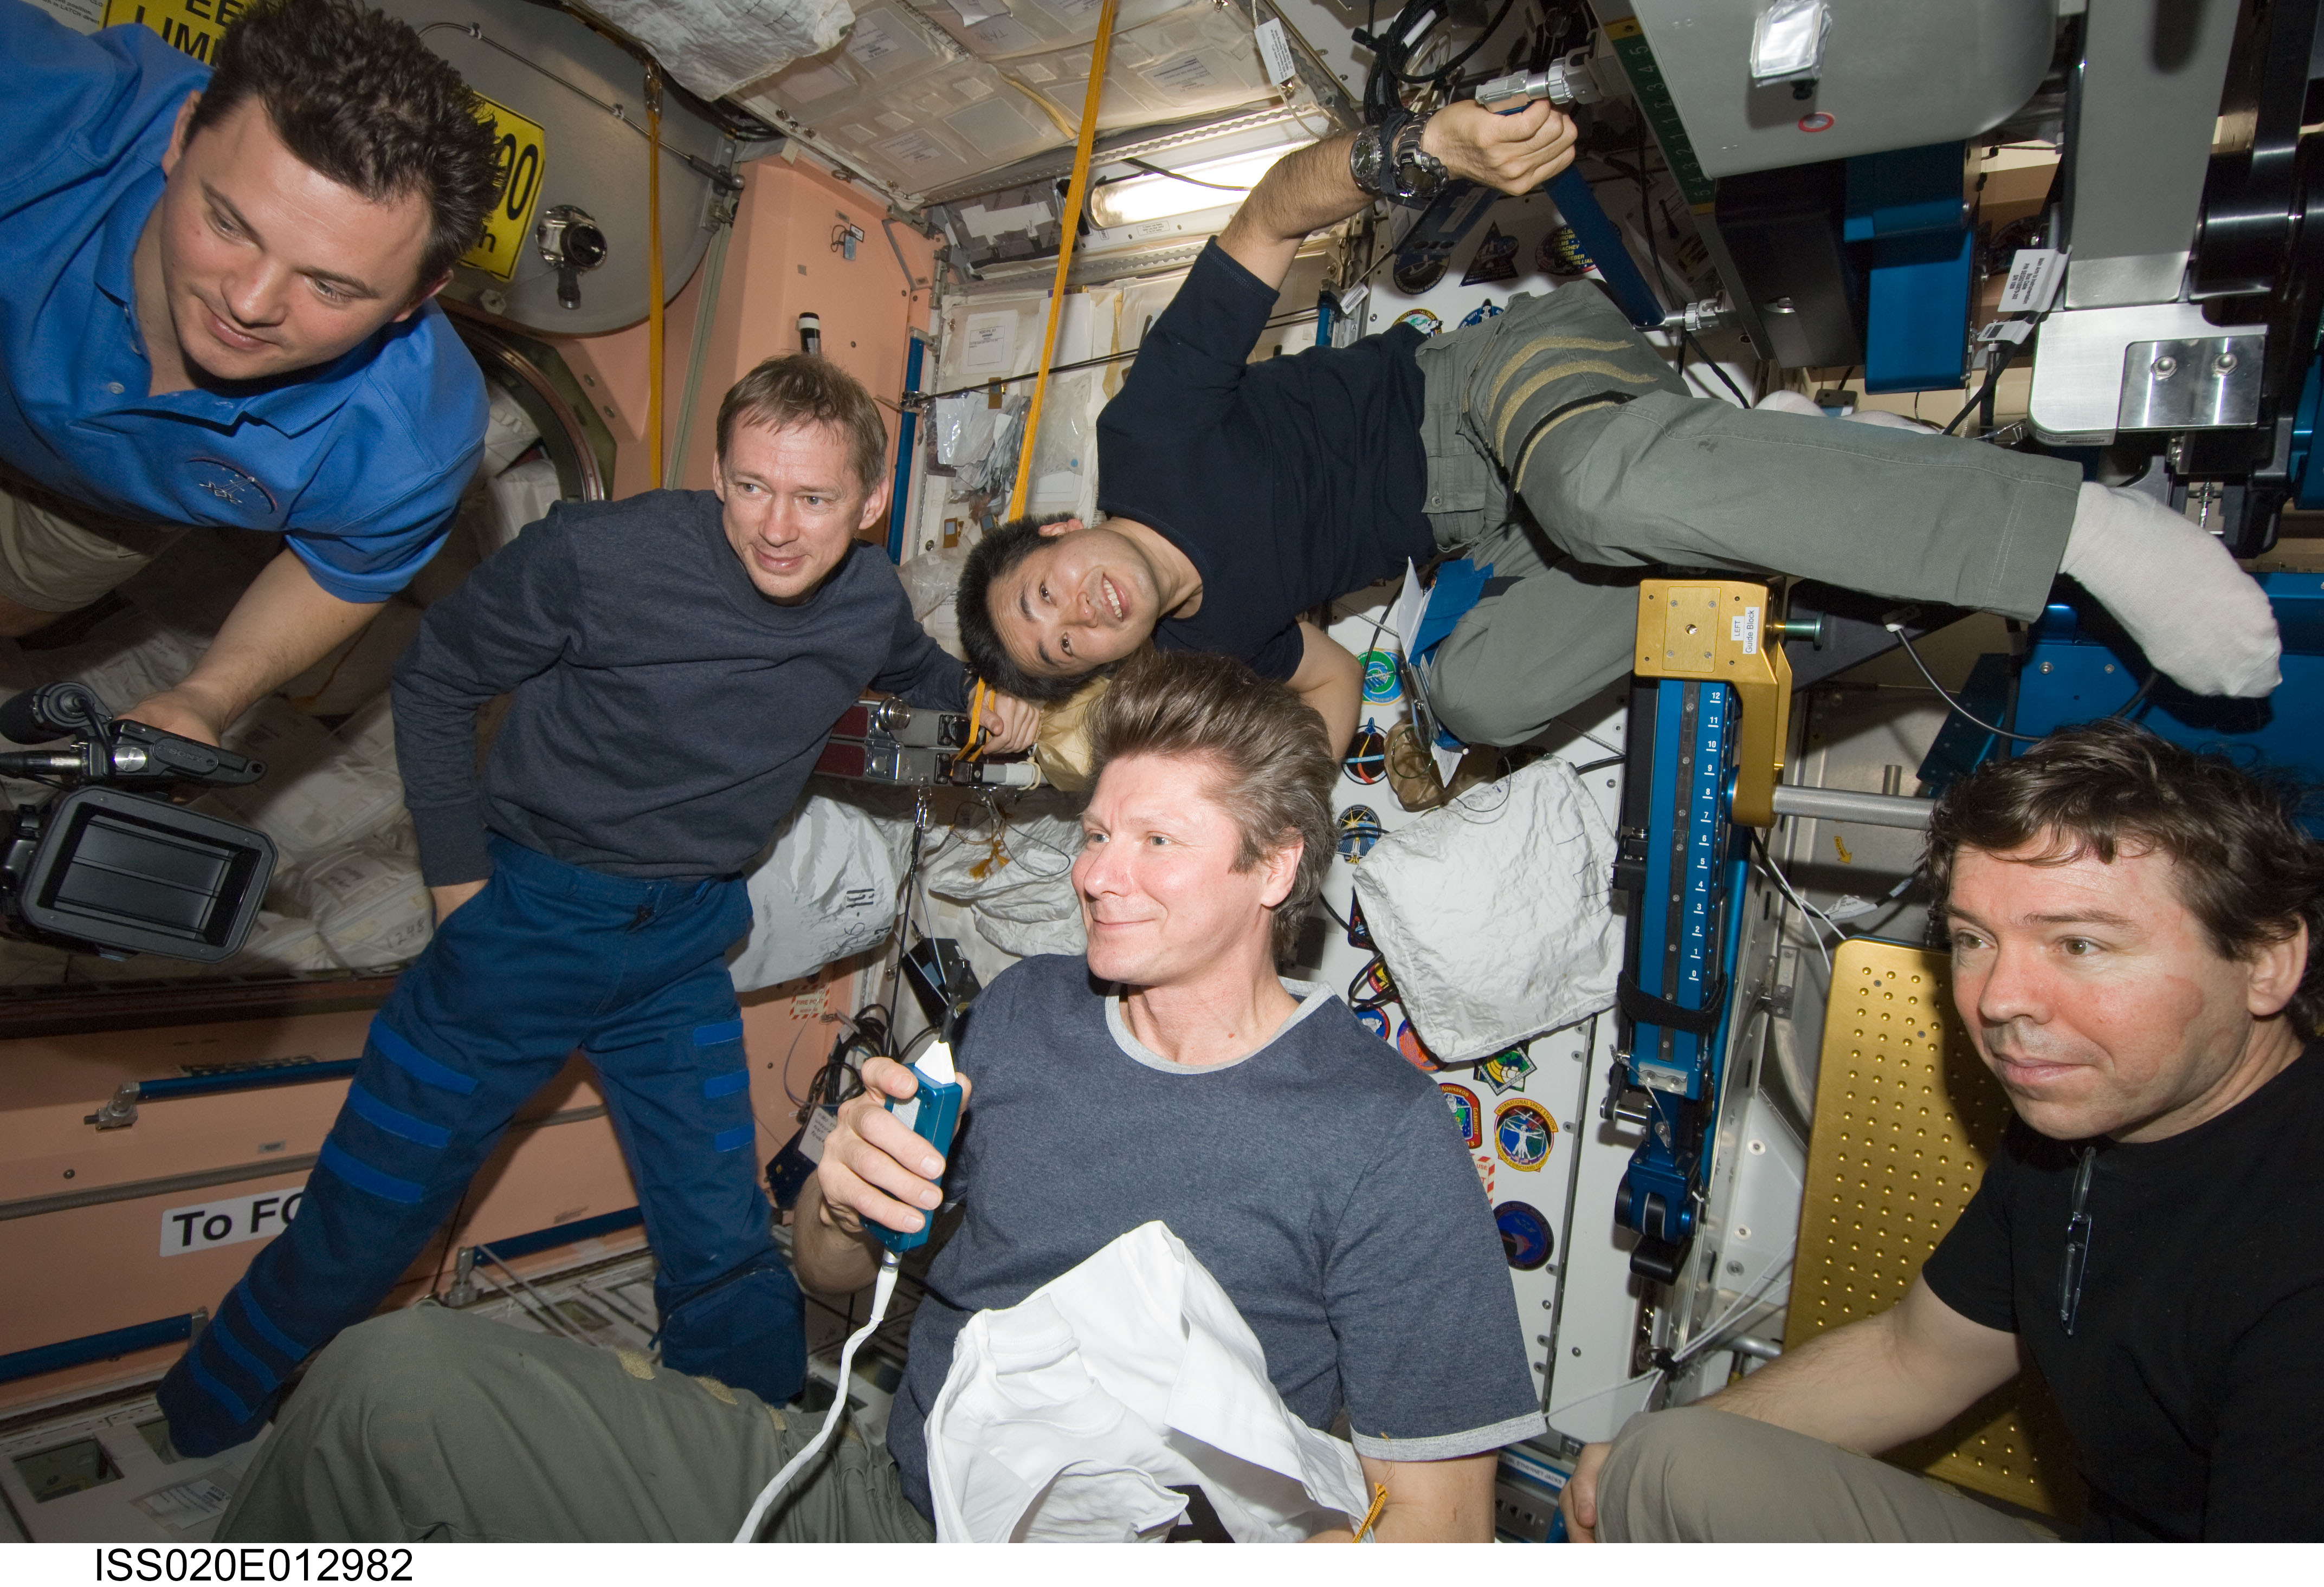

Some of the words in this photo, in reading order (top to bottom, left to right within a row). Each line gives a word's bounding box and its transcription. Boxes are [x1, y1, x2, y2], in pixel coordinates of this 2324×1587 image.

[1629, 46, 1648, 54] 5
[1647, 82, 1664, 91] 3
[1676, 147, 1693, 156] 2
[1468, 312, 1478, 321] DUFFY
[1712, 691, 1720, 700] 12
[1710, 716, 1719, 724] 11
[1708, 740, 1716, 749] 10
[169, 748, 203, 762] SONY
[1707, 764, 1713, 772] 9
[1706, 788, 1710, 796] 8
[1704, 811, 1709, 819] 7
[1702, 834, 1707, 843] 6
[1700, 857, 1705, 865] 5
[1698, 880, 1703, 889] 4
[1696, 903, 1702, 911] 3
[1695, 925, 1700, 934] 2
[1694, 948, 1697, 956] 1
[1692, 970, 1697, 979] 0
[1497, 1099, 1528, 1113] INTERNATIONAL
[1530, 1102, 1543, 1113] SPACE
[1543, 1112, 1555, 1130] STATION
[172, 1210, 233, 1247] To
